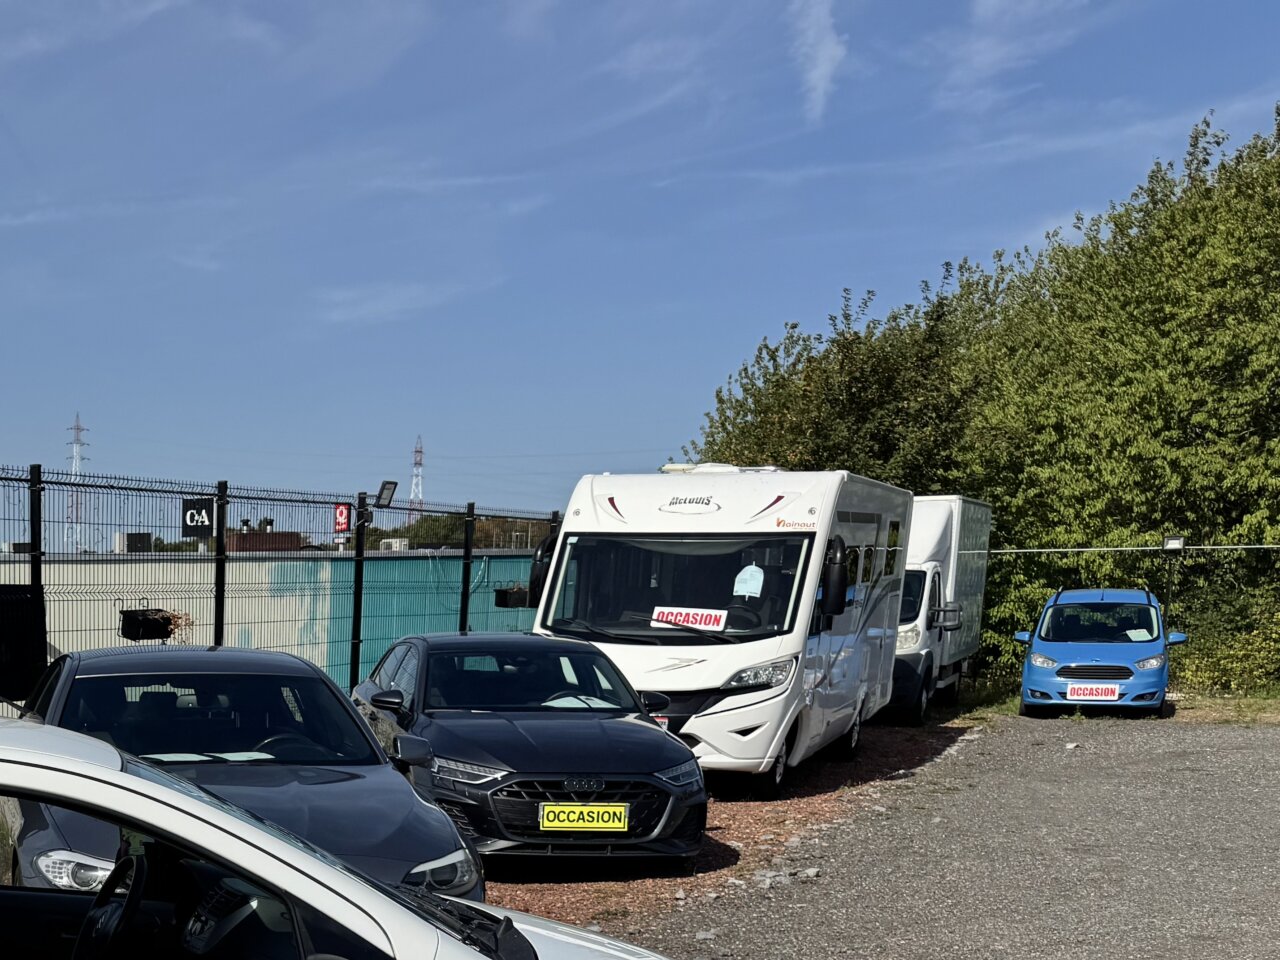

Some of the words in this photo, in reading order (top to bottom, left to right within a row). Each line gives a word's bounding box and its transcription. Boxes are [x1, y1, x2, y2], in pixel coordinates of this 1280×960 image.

[656, 611, 722, 627] OCCASION
[1070, 686, 1116, 697] OCCASION
[546, 810, 622, 823] OCCASION
